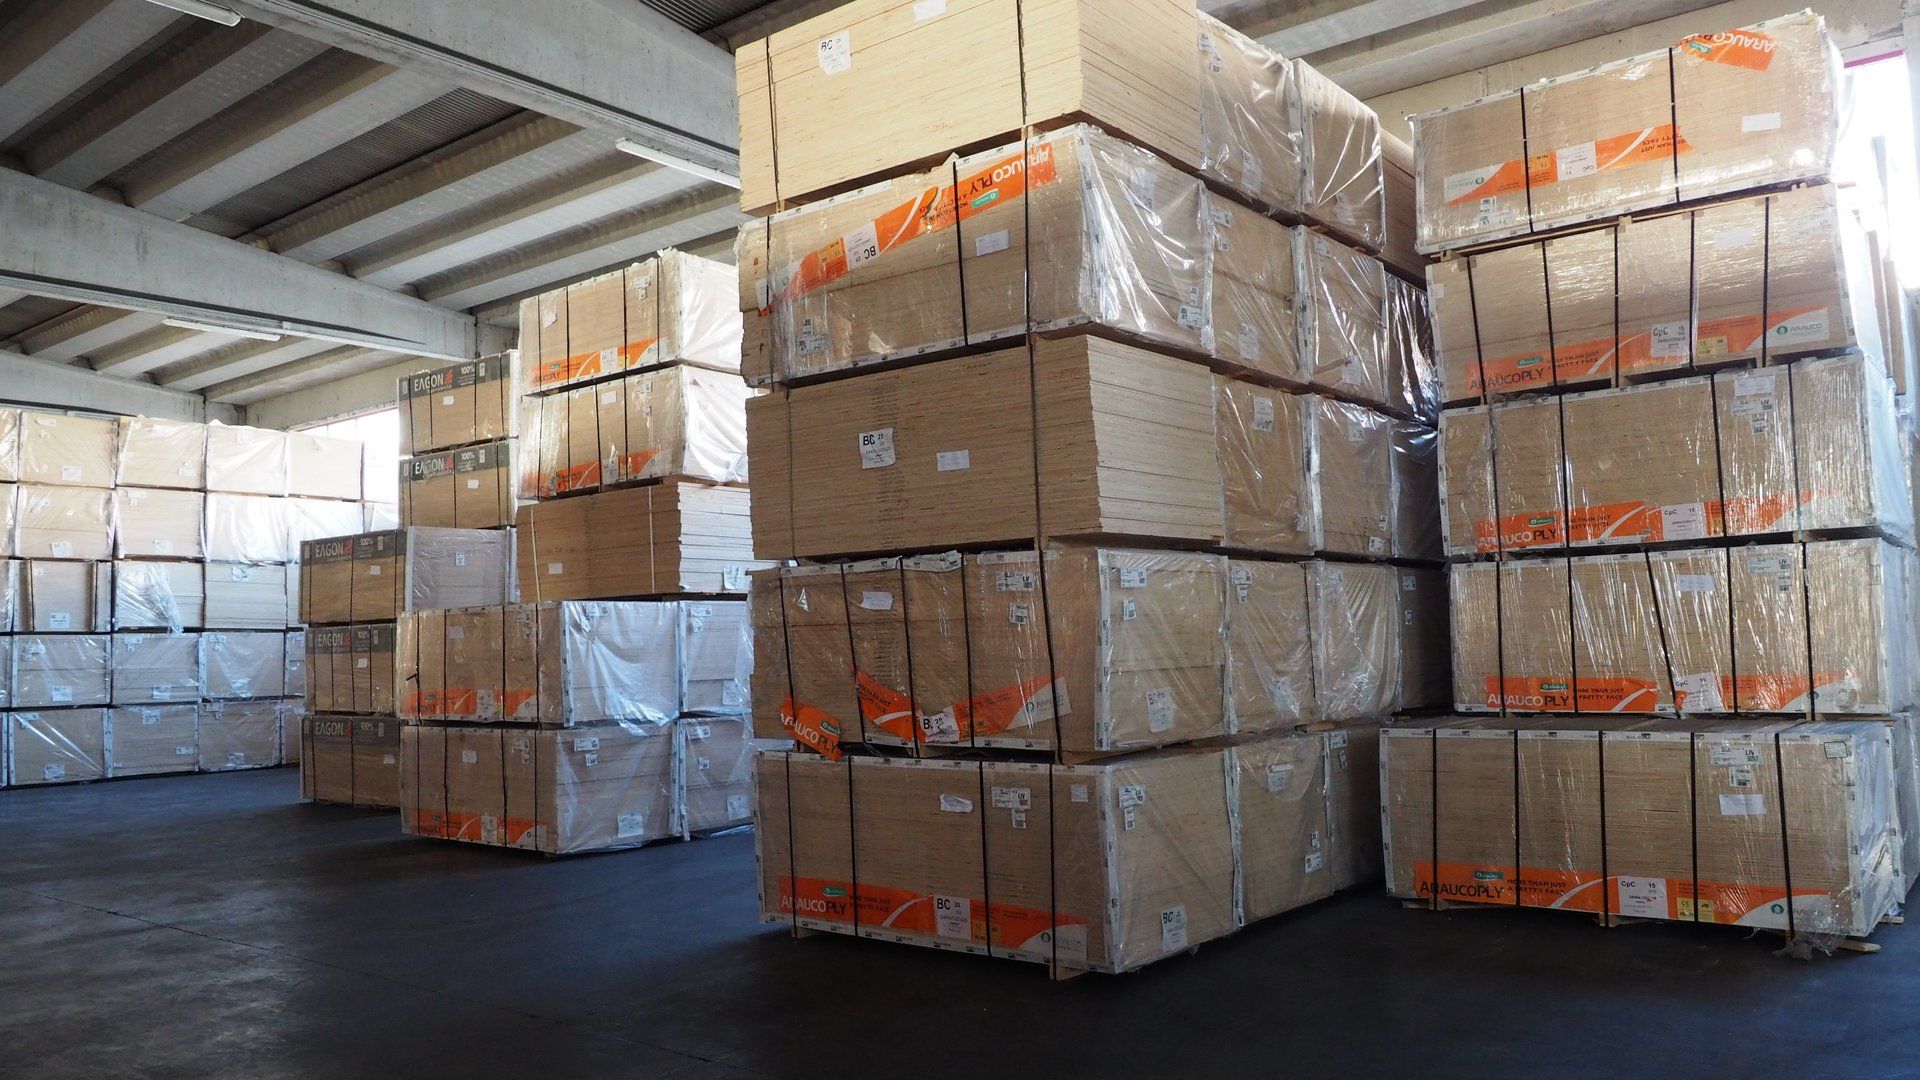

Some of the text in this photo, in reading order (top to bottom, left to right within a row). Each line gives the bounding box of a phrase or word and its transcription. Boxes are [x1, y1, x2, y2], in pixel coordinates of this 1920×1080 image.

[414, 373, 444, 392] EAGON
[863, 434, 875, 446] BC
[415, 457, 444, 475] EAGON
[315, 542, 344, 558] EAGON
[937, 898, 951, 910] BC
